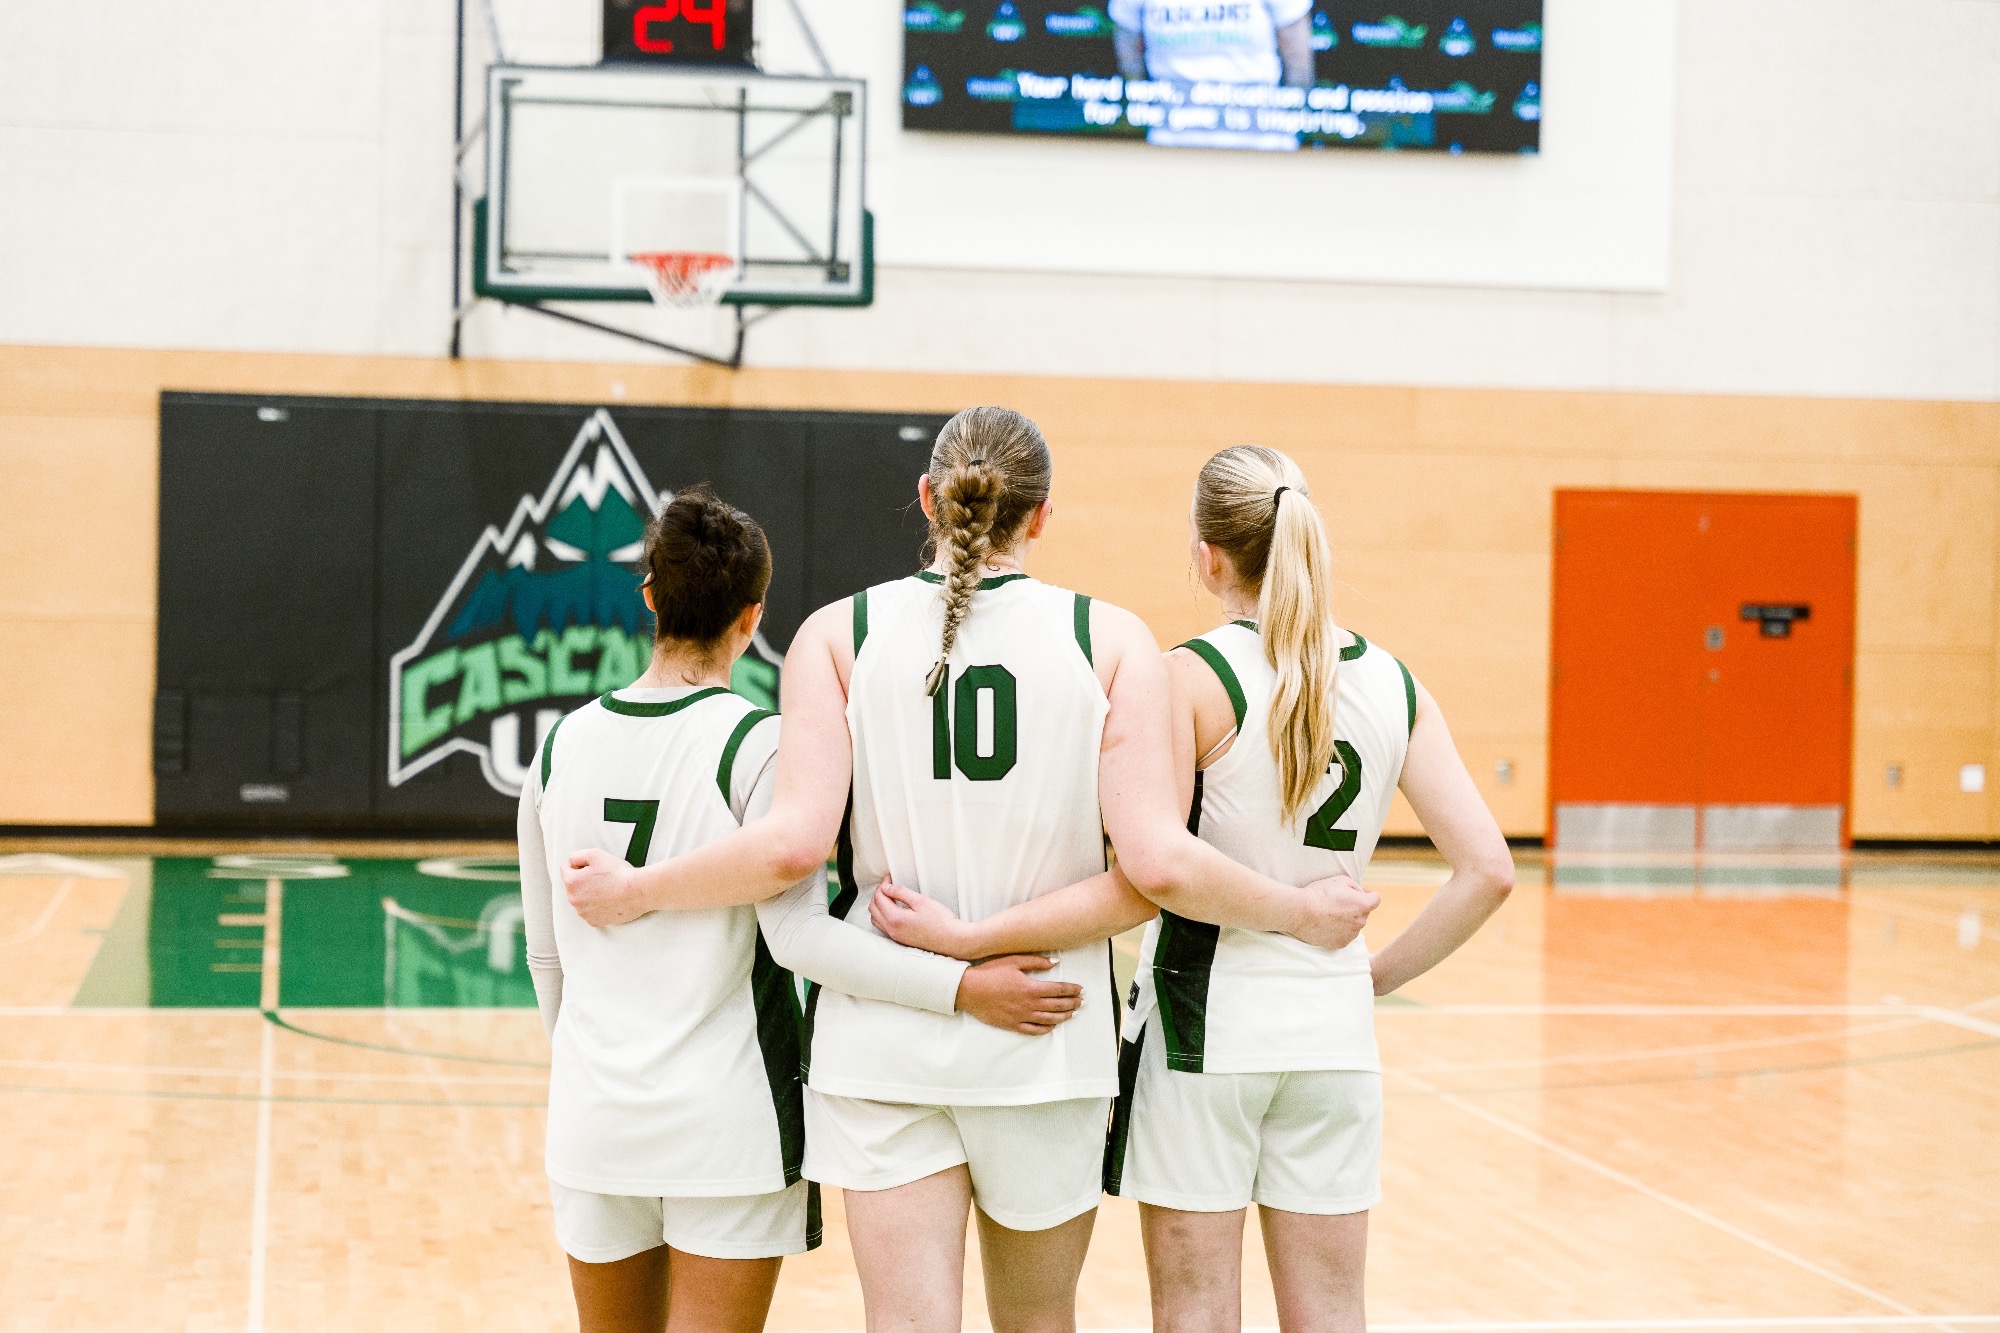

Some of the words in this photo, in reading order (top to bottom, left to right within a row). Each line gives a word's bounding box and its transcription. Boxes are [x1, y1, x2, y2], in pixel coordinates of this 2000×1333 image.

[633, 0, 727, 53] 24
[1017, 71, 1069, 98] Your
[1307, 83, 1349, 110] and
[925, 661, 1017, 781] 10
[1303, 740, 1362, 851] 2
[604, 798, 660, 868] 7
